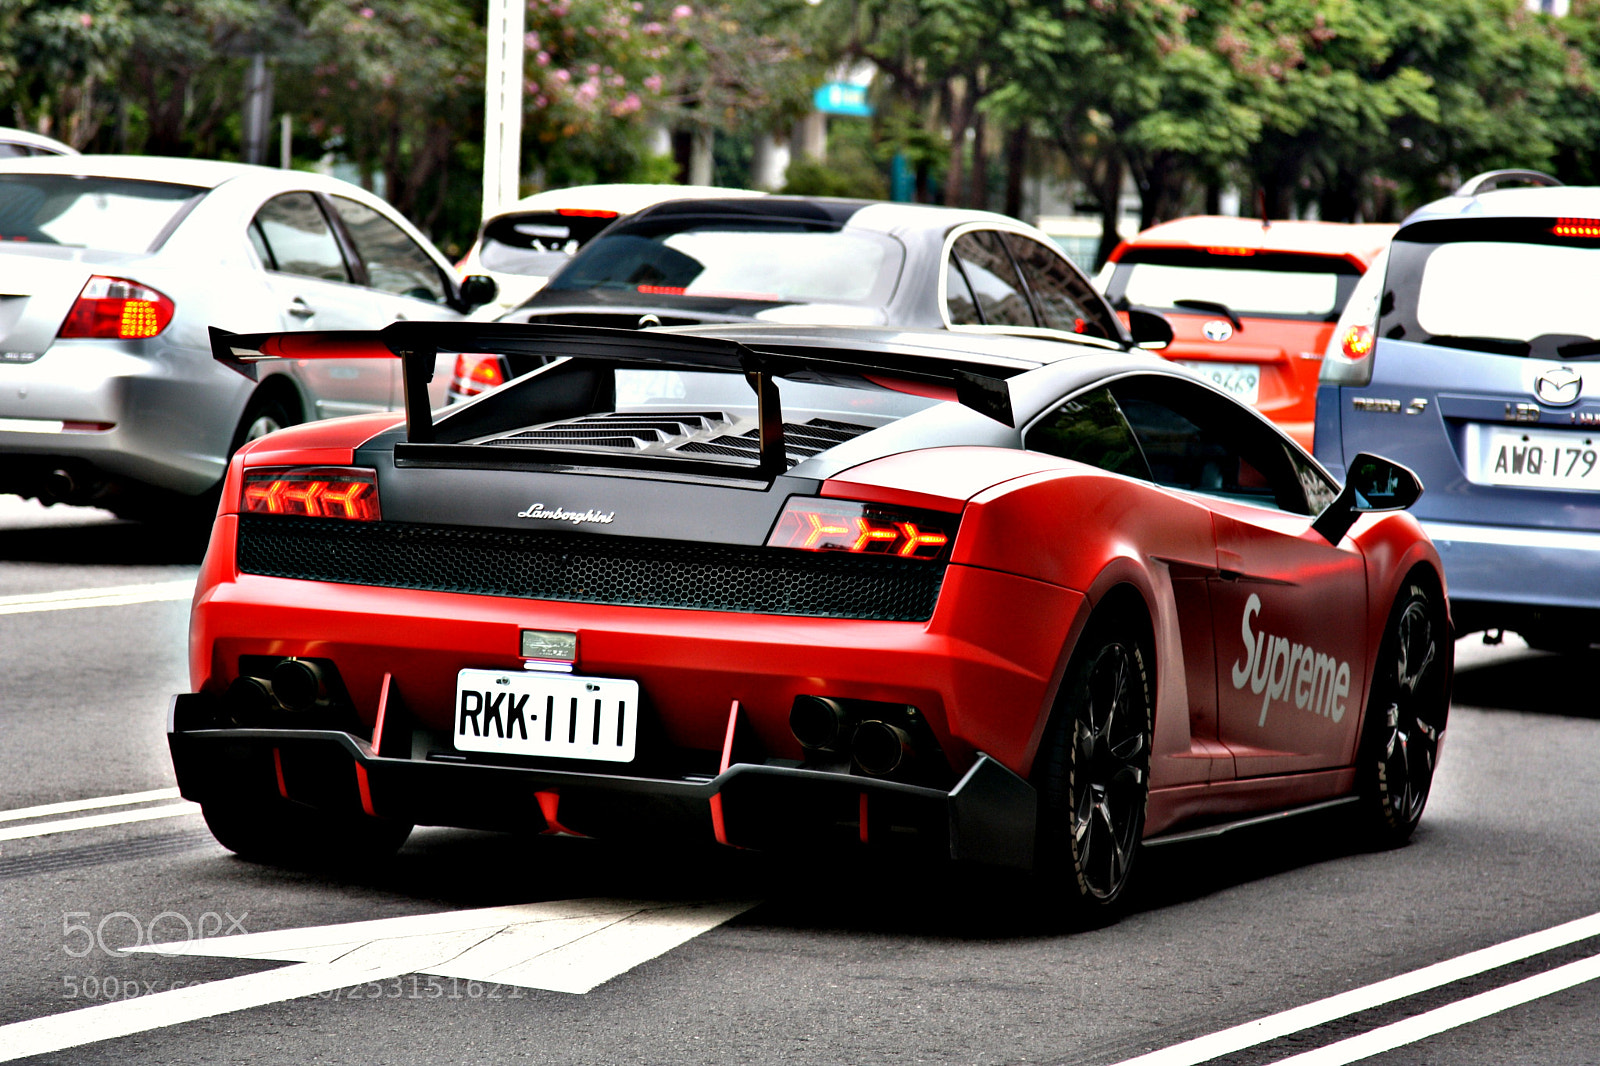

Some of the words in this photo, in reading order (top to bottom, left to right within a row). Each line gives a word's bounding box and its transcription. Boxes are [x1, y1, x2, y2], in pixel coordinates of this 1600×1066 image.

[518, 503, 615, 525] Lamborghini
[1232, 593, 1351, 728] Supreme
[459, 689, 626, 747] RKK-1111
